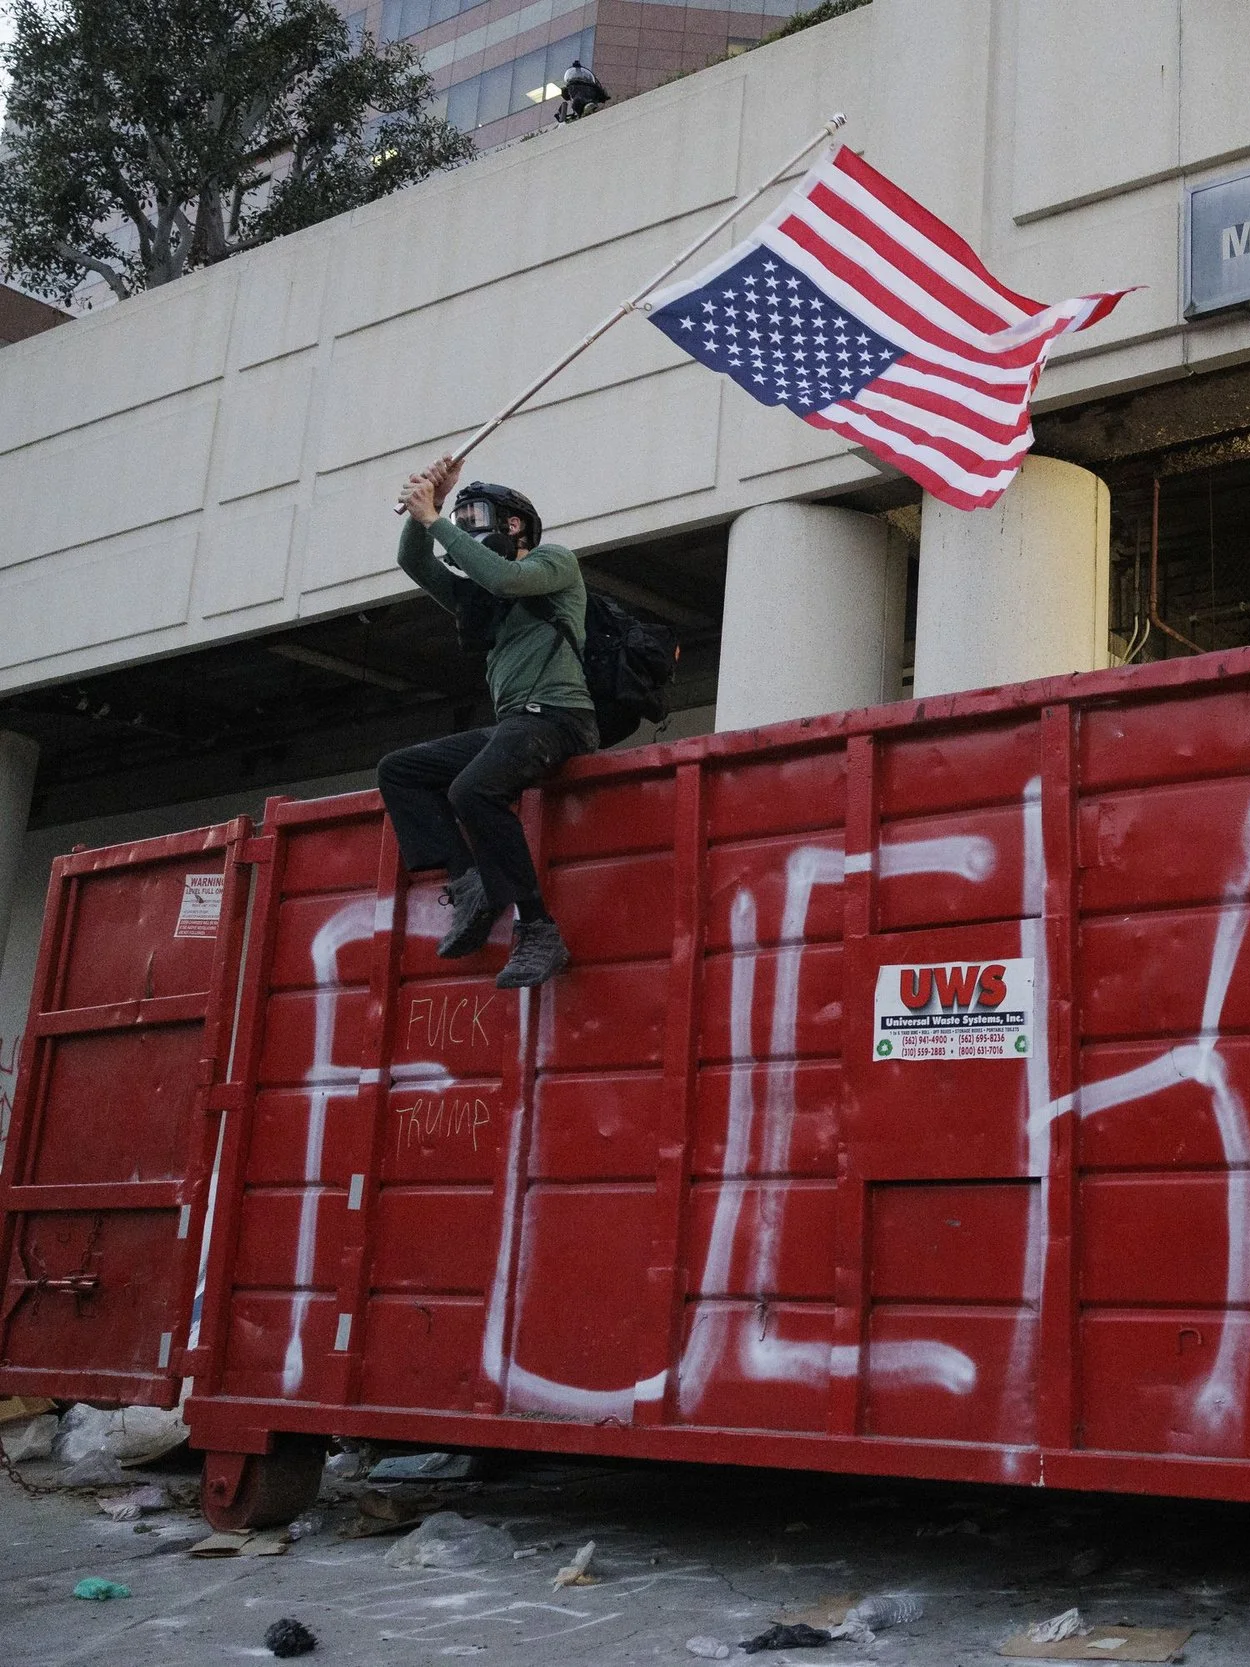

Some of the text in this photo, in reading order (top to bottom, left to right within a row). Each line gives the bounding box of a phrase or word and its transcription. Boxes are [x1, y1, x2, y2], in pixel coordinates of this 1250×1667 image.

[900, 965, 1008, 1010] UWS
[406, 994, 496, 1050] FUCK
[885, 1013, 1024, 1027] Universal Waste Systems, Inc.
[901, 1047, 916, 1058] (310)
[958, 1046, 975, 1056] (800)
[902, 1035, 917, 1047] (562)
[919, 1035, 948, 1044] 941-4900
[958, 1034, 974, 1045] (562)
[395, 1098, 490, 1161] TRUMP
